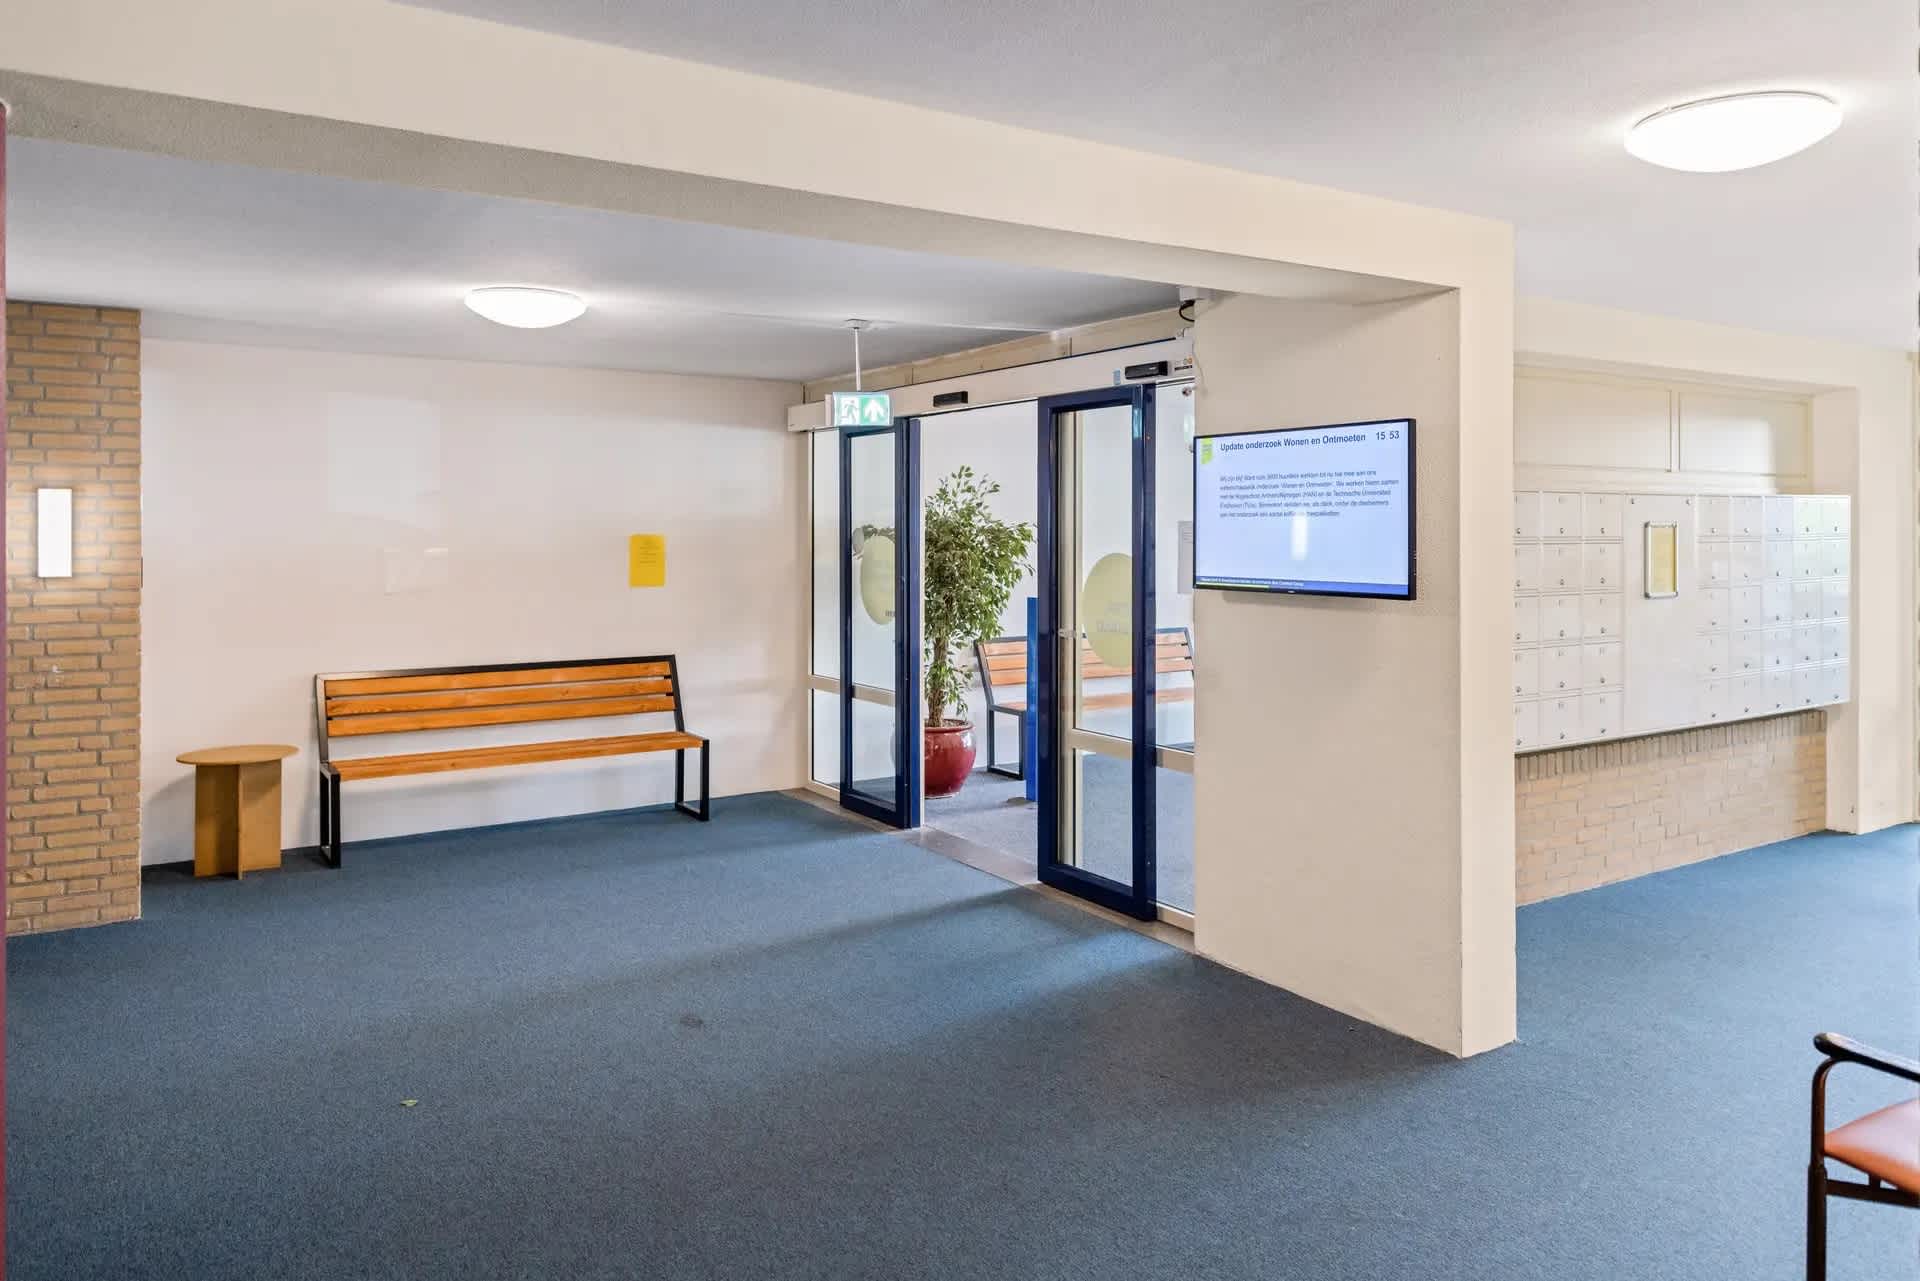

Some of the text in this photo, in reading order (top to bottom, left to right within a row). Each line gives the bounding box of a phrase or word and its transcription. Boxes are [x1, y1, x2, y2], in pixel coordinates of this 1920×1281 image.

[1376, 430, 1400, 440] 15 53
[1220, 442, 1244, 452] Update
[1245, 439, 1282, 449] onderzoek
[1283, 438, 1310, 447] Wonen
[1322, 434, 1366, 444] Ontmoeten
